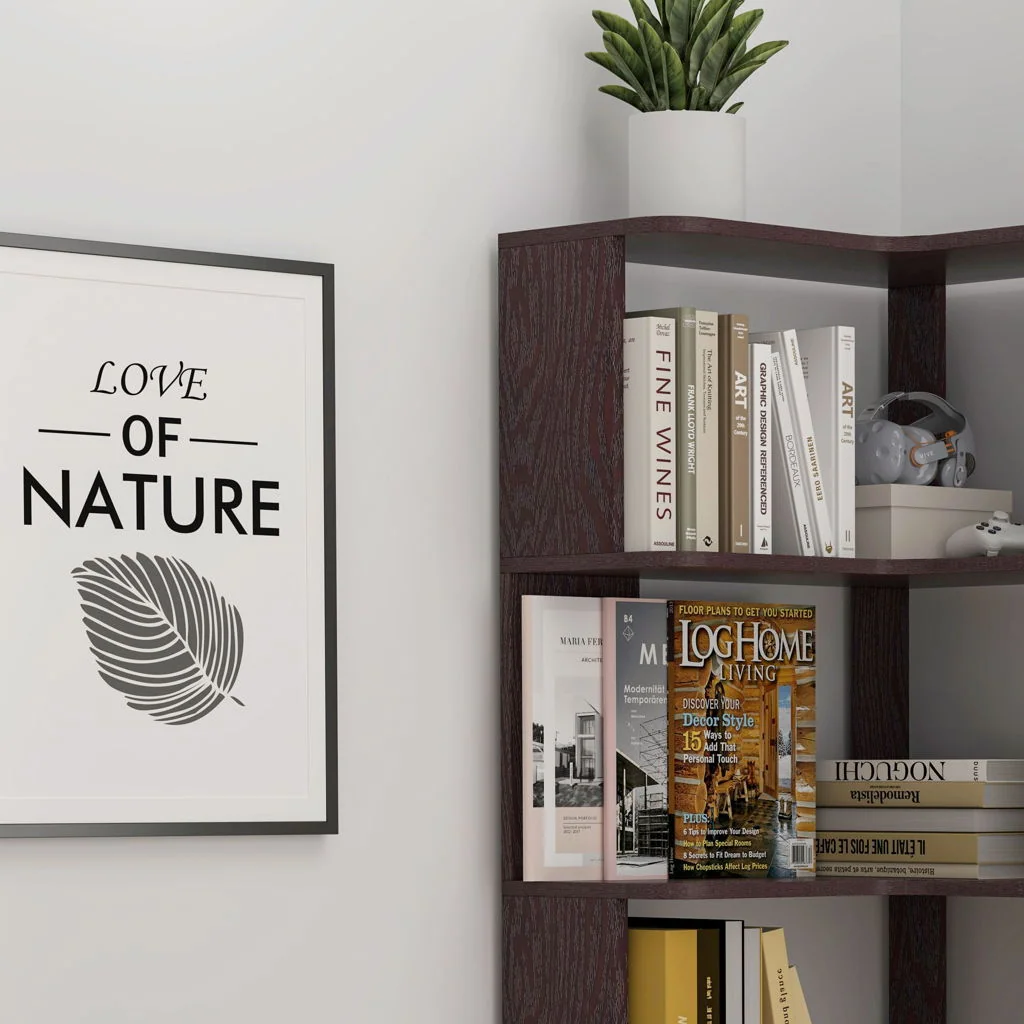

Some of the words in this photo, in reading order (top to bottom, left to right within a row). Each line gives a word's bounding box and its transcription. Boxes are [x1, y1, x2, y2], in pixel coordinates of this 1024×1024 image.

[90, 361, 208, 400] LOVE
[656, 351, 671, 413] FINE
[735, 371, 747, 409] ART
[688, 385, 696, 413] FRANK
[842, 381, 853, 418] ART
[122, 415, 181, 457] OF
[688, 415, 696, 444] LLOYD
[688, 445, 696, 474] WRIGHT
[785, 434, 801, 487] BORDEAUX
[807, 437, 819, 478] SAARINEN
[656, 427, 671, 519] WINES
[23, 466, 279, 536] NATURE
[814, 480, 823, 501] EERO
[679, 606, 704, 615] FLOOR
[706, 606, 731, 616] PLANS
[733, 606, 744, 616] TO
[746, 607, 760, 617] GET
[762, 608, 778, 617] YOU
[780, 608, 813, 619] STARTED
[560, 636, 586, 646] MARIA
[720, 664, 776, 682] LIVING
[624, 684, 665, 694] Modernität
[683, 699, 719, 710] DISCOVER
[721, 700, 740, 710] YOUR
[683, 713, 720, 728] Decor
[722, 713, 754, 730] Style
[683, 731, 702, 751] 15
[704, 730, 722, 740] Ways
[724, 731, 732, 739] to
[704, 742, 718, 752] Add
[720, 742, 736, 752] That
[684, 754, 714, 764] Personal
[717, 754, 738, 764] Touch
[836, 761, 945, 781] NOGUCHI
[850, 790, 920, 804] Remodelista
